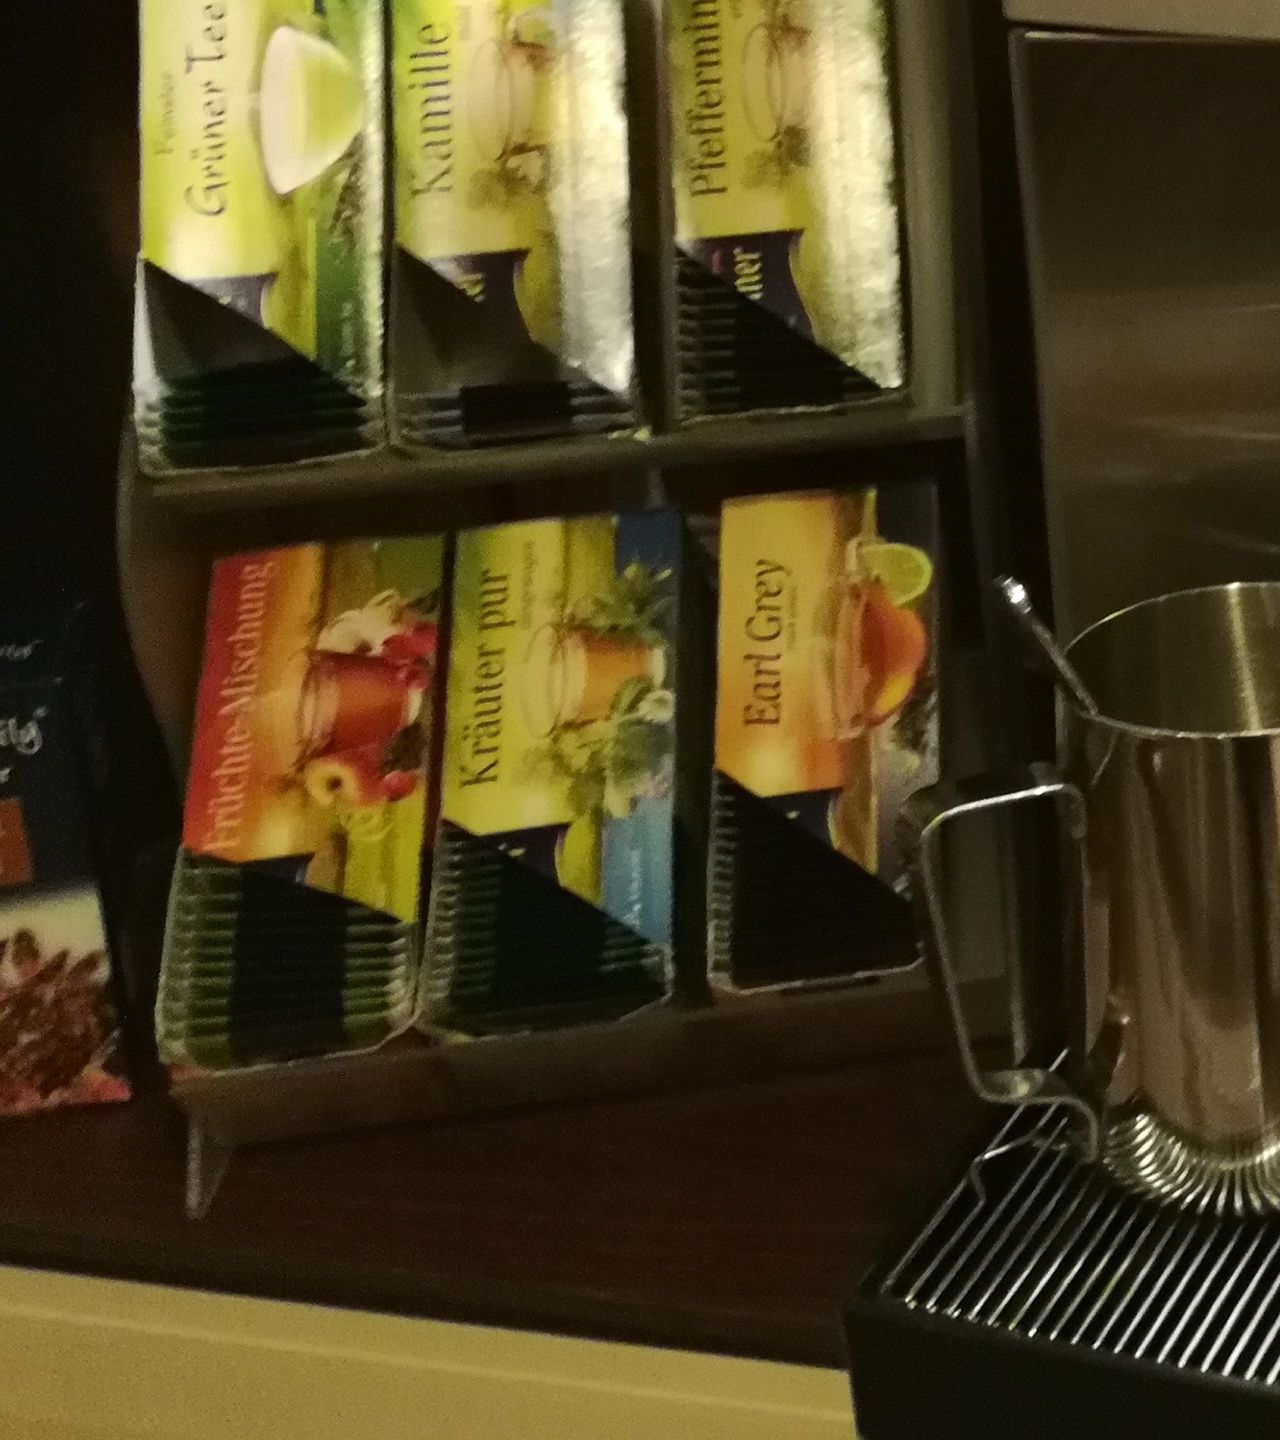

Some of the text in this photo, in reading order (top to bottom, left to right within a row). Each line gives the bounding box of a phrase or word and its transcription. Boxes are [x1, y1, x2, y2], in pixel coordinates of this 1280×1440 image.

[183, 0, 231, 218] Grüner Tee
[406, 21, 455, 197] Kamille
[202, 560, 276, 853] Früchte-Mischung
[459, 567, 516, 789] Kräuter pur
[742, 557, 793, 727] Earl Grey
